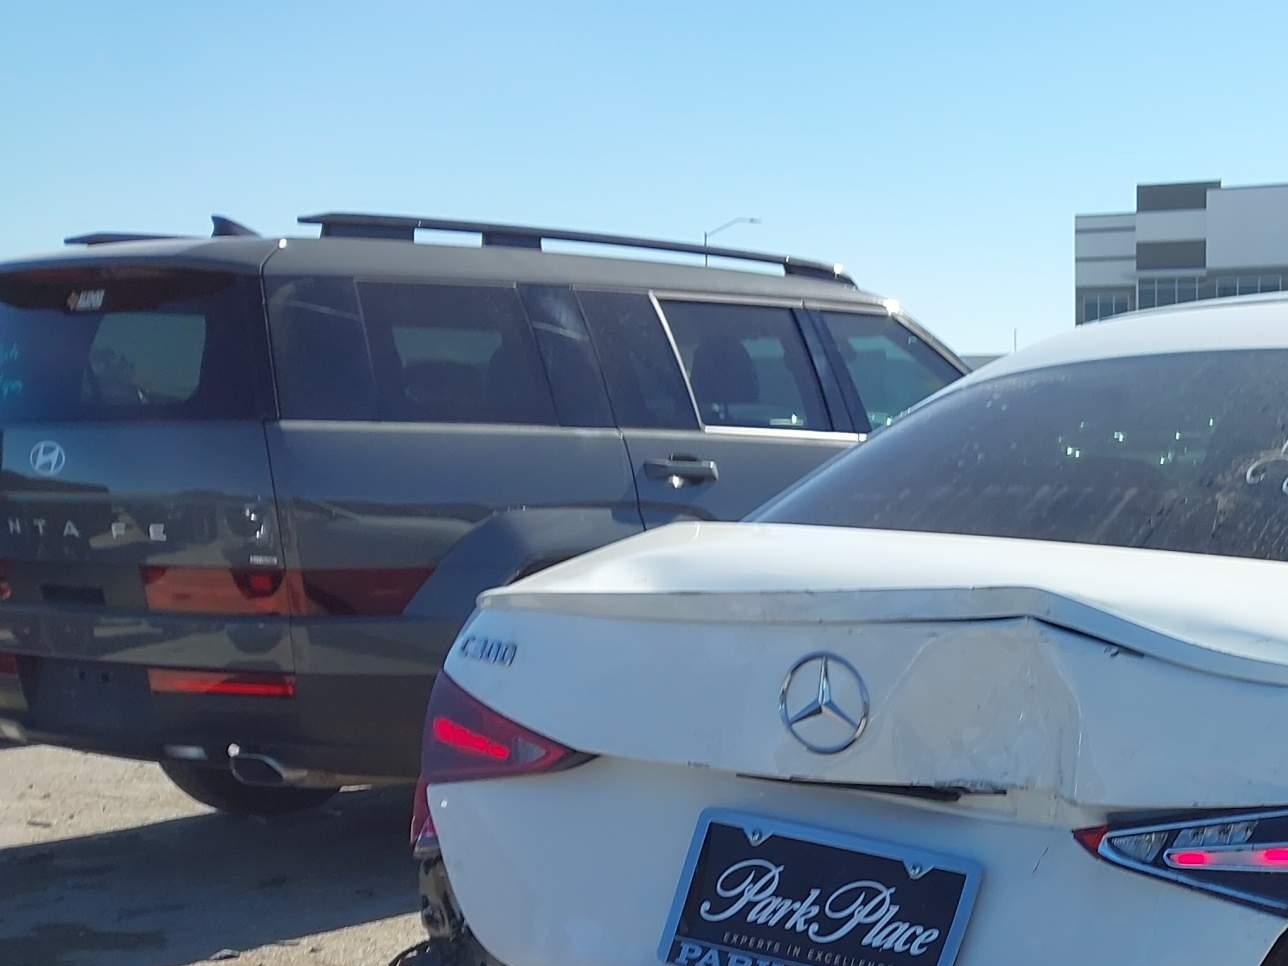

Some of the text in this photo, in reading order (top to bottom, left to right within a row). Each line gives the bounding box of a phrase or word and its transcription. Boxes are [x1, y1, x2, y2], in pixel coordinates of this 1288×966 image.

[8, 519, 80, 538] NTA
[700, 859, 940, 956] Park Place
[723, 932, 780, 952] EXPERTS
[786, 943, 801, 958] IN
